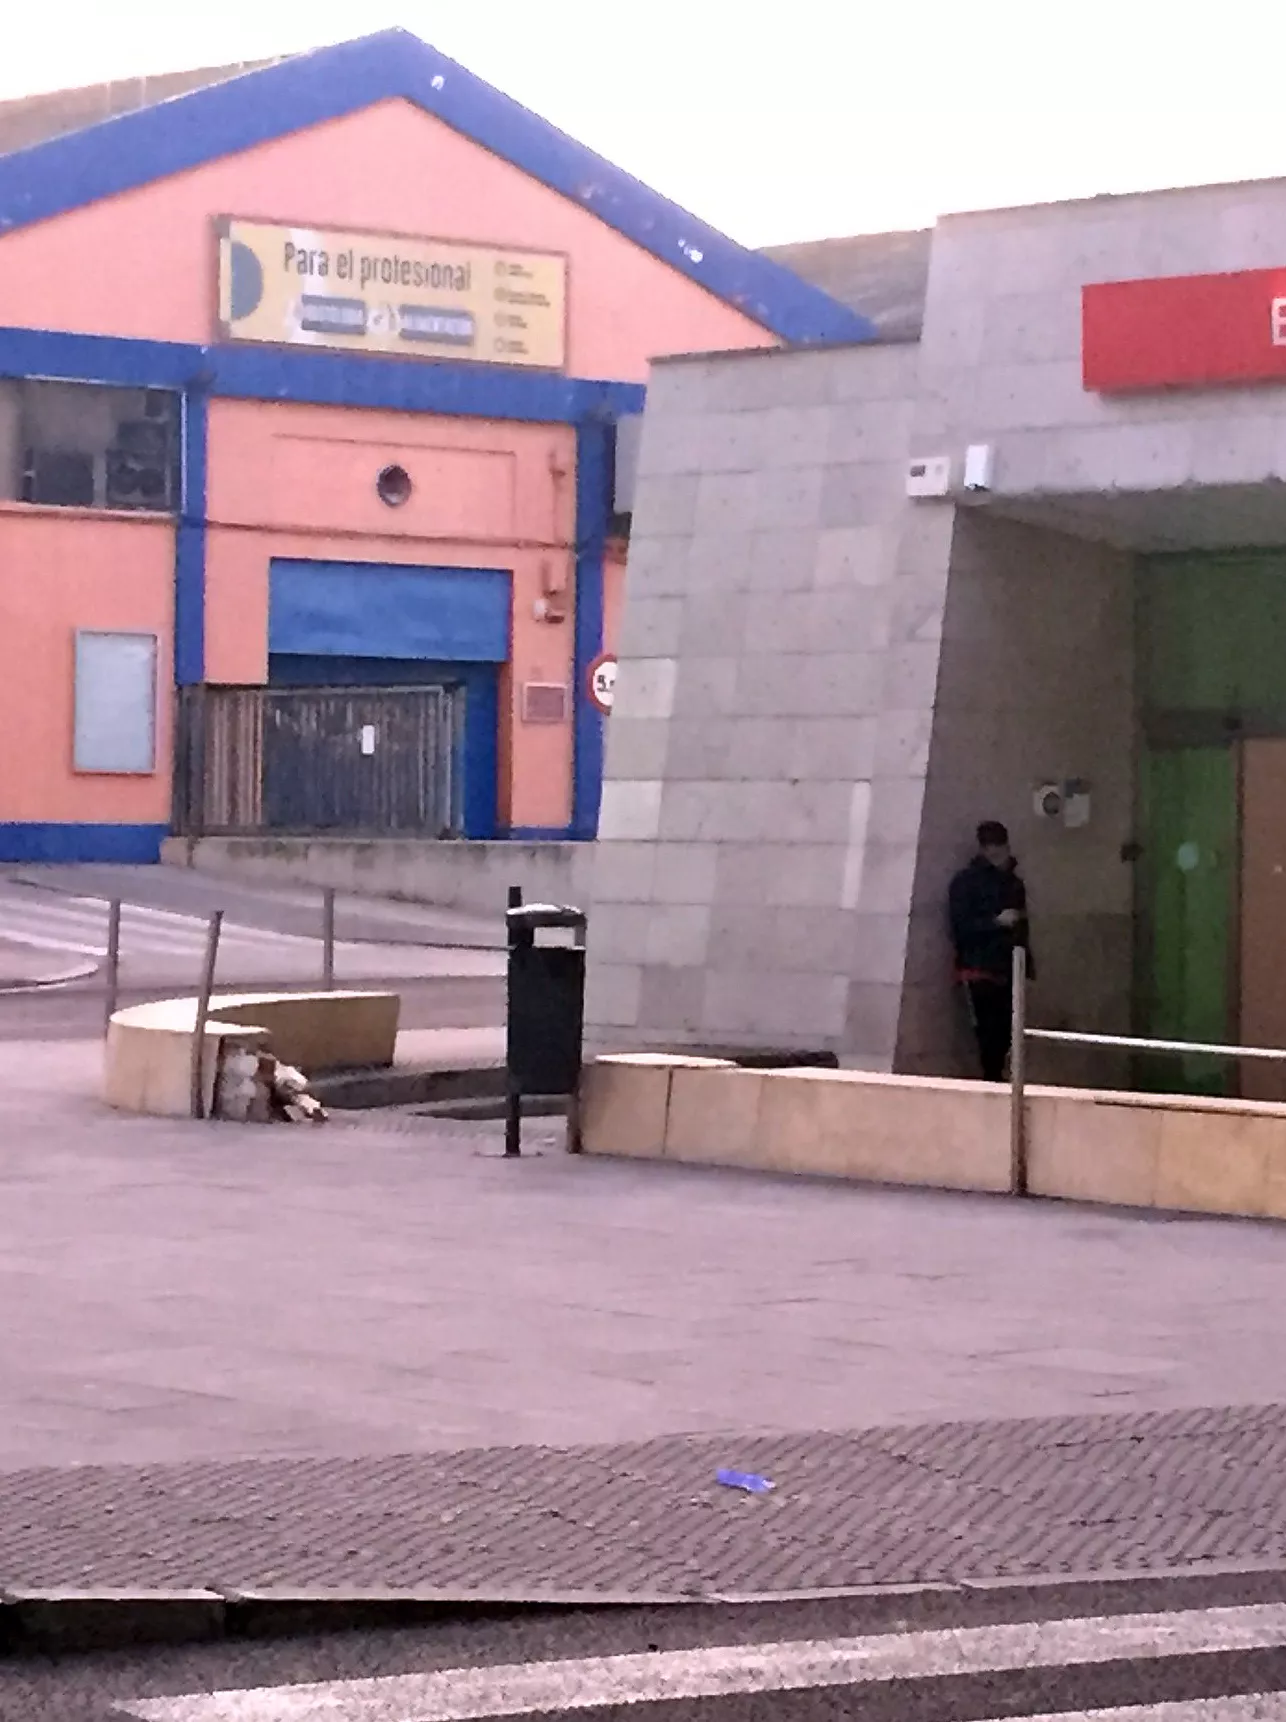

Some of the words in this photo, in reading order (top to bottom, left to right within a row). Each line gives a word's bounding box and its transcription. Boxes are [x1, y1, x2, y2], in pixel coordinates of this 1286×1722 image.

[284, 241, 329, 277] Para
[336, 250, 354, 282] el
[361, 254, 472, 291] profesional
